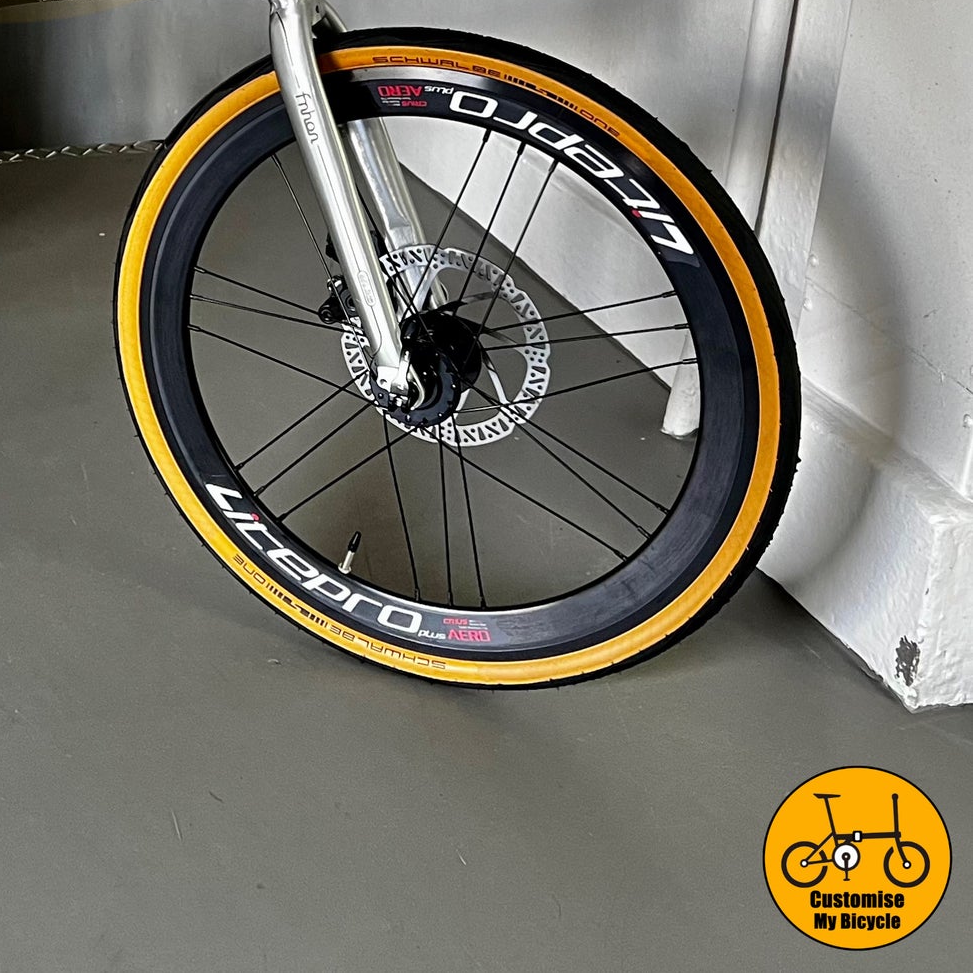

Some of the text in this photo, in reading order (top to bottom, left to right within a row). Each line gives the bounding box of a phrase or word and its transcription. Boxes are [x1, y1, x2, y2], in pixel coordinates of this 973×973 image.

[372, 56, 501, 77] SCHWALBE
[378, 85, 423, 97] AERO
[295, 92, 319, 145] fnhon
[579, 109, 621, 138] ONE
[449, 90, 694, 255] Litepro
[205, 483, 491, 642] Litepro plus AERO
[232, 553, 267, 585] ONE
[329, 623, 447, 670] SCHWALBE
